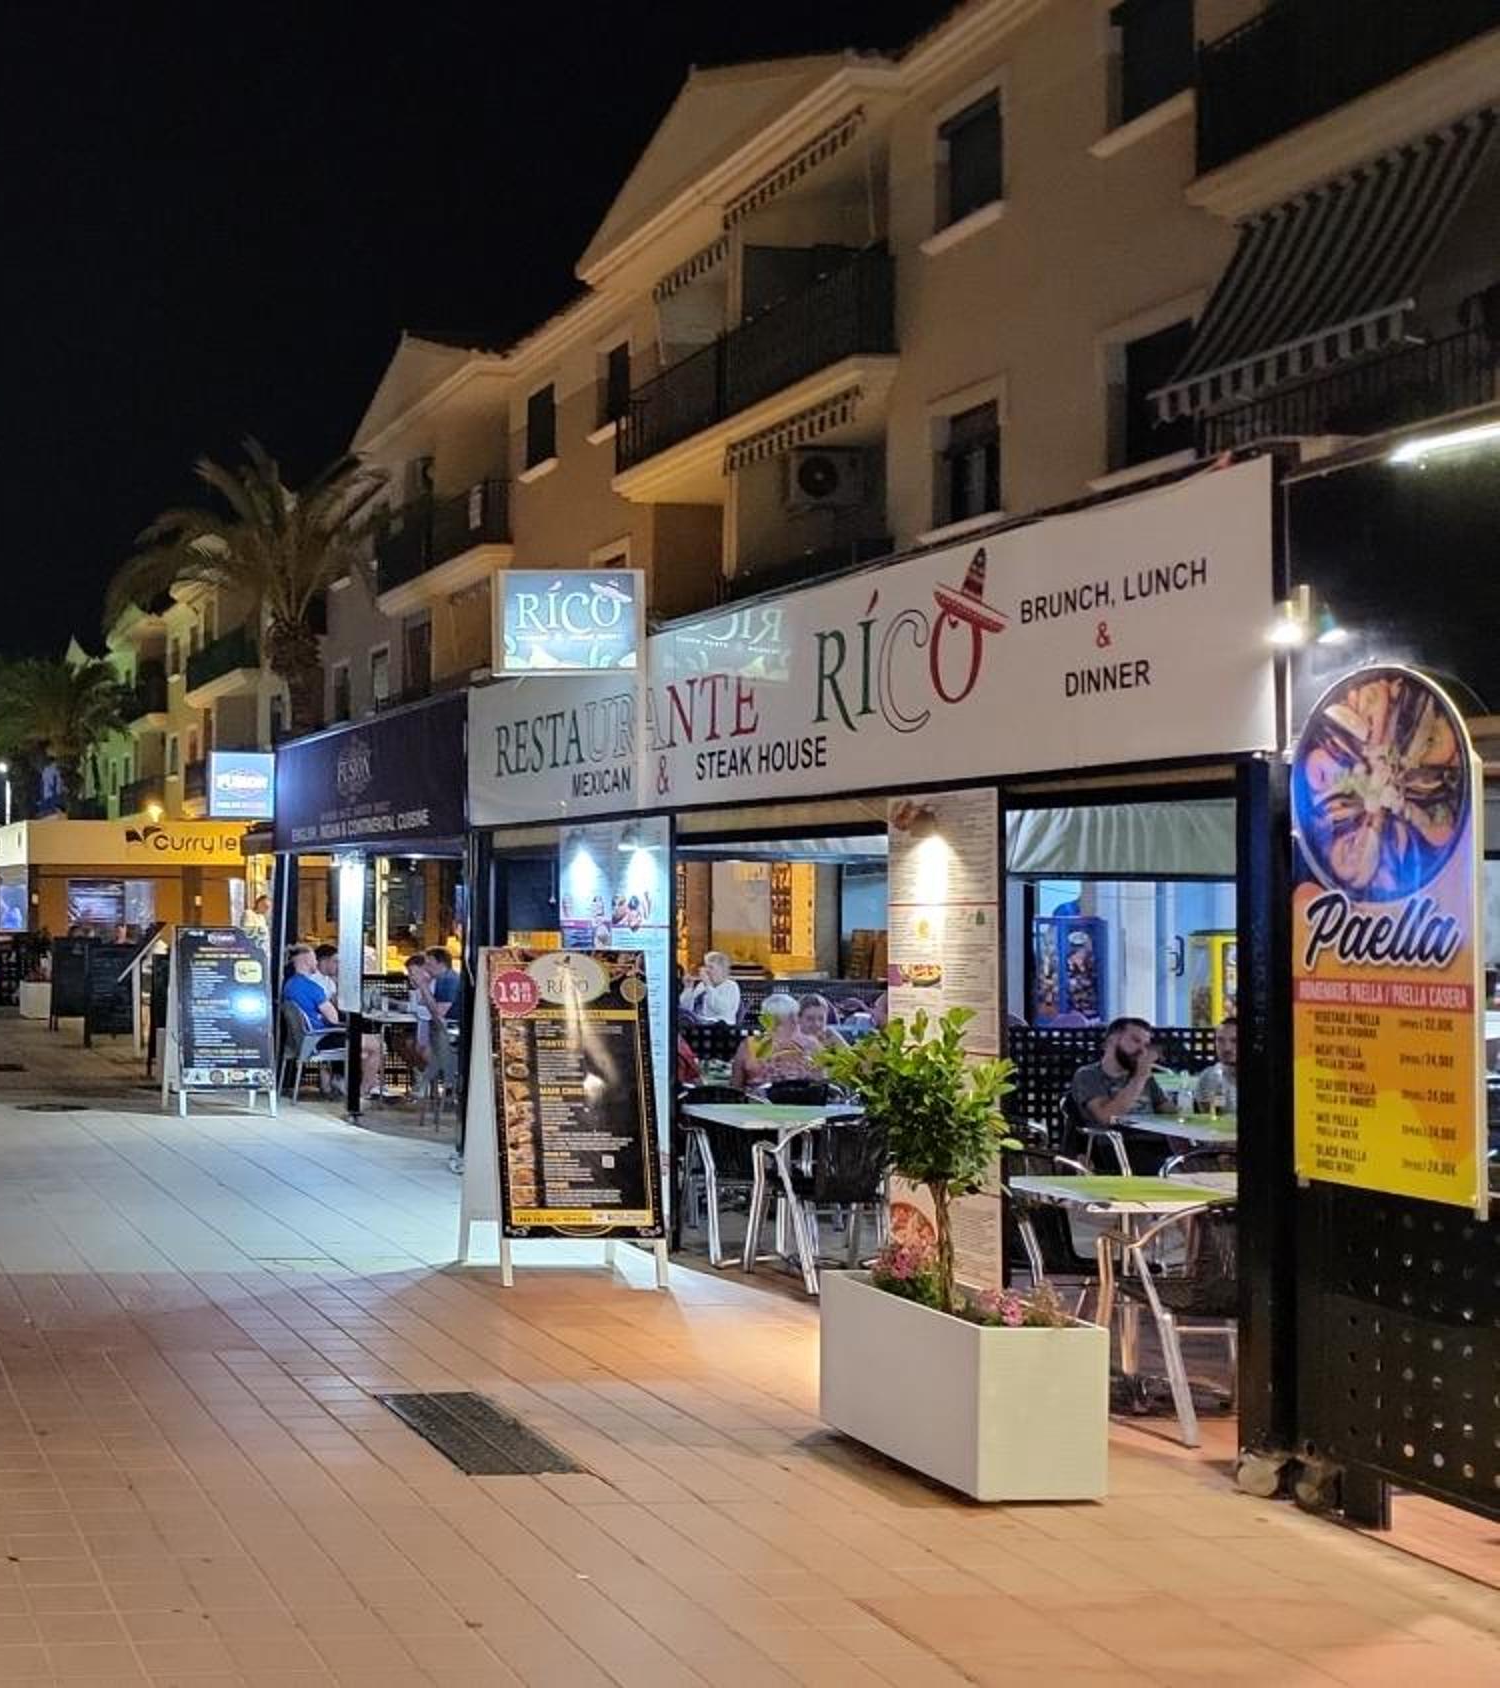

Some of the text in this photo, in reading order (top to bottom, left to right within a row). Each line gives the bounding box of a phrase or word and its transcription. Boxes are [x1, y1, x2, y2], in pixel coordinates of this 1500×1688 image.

[515, 580, 622, 635] RÍCO
[1020, 558, 1208, 625] BRUNCH, LUNCH
[1095, 622, 1111, 648] &
[494, 588, 984, 778] RESTAURANTE RÍCO
[1065, 659, 1151, 698] DINNER
[573, 736, 828, 798] MEXICAN & STEAK HOUSE
[1305, 891, 1461, 968] Paella
[1349, 982, 1383, 1003] PAELLA
[1392, 984, 1426, 1006] PAELLA
